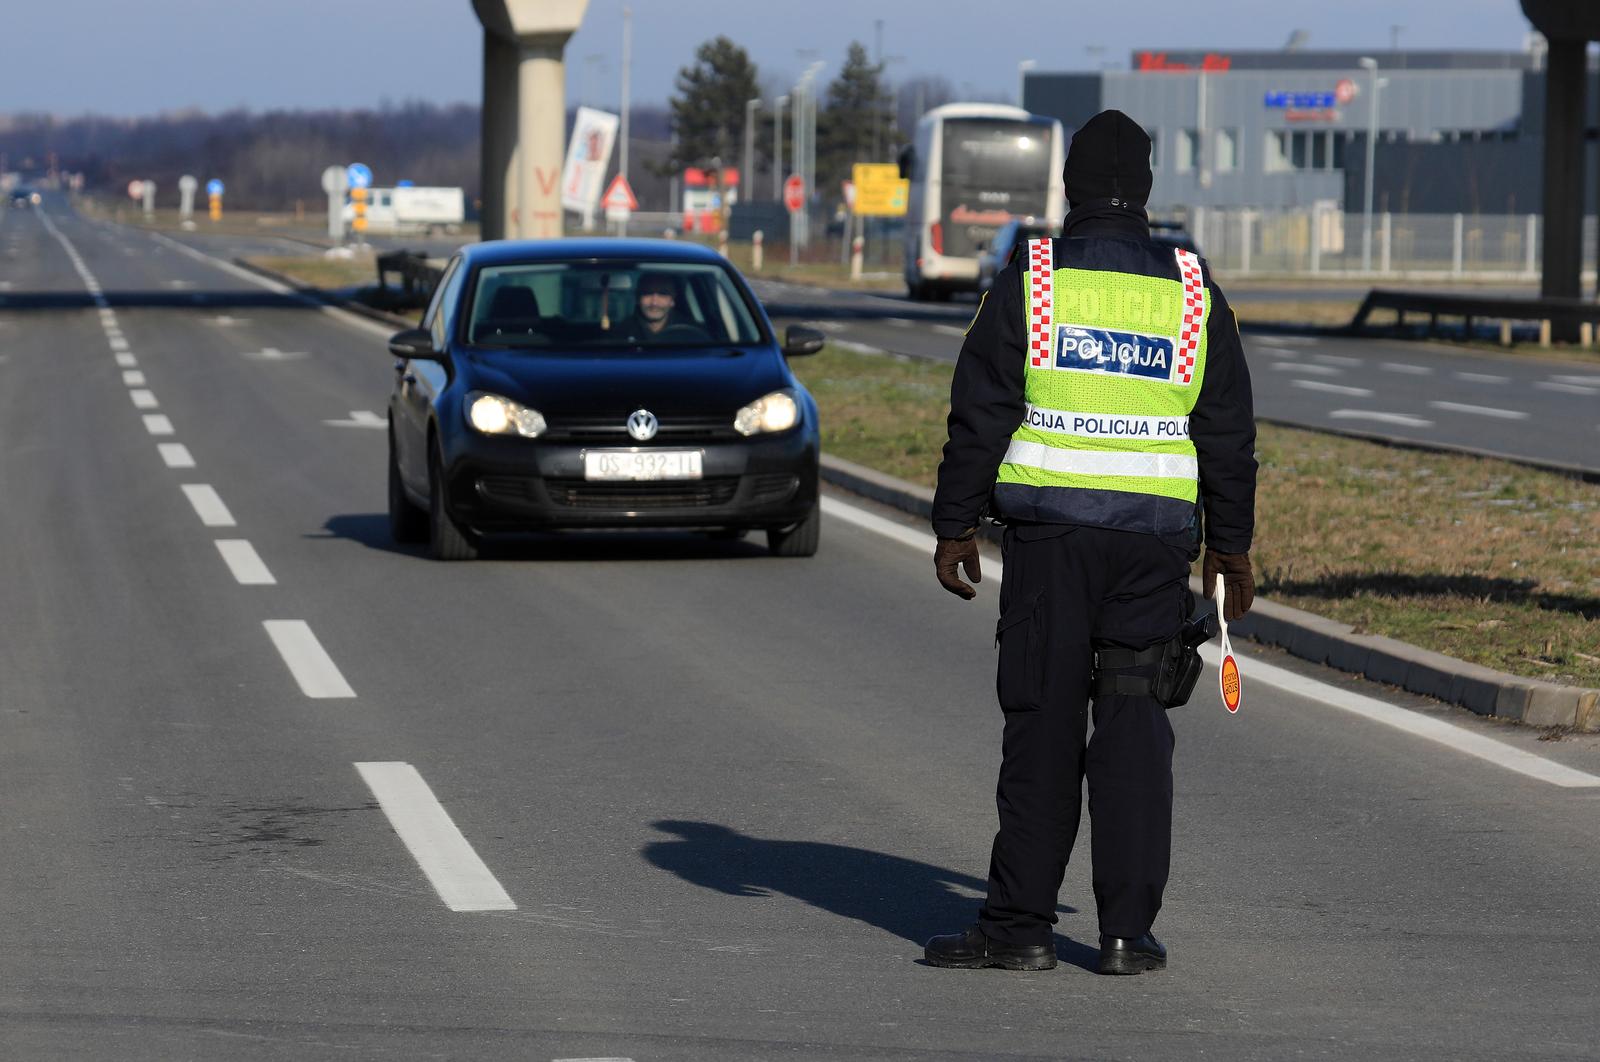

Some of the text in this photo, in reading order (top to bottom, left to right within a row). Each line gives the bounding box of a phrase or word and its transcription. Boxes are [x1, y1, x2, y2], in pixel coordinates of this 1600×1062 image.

[1061, 337, 1167, 369] POLICIJA
[1073, 417, 1150, 435] POLICIJA
[599, 454, 620, 473] OS
